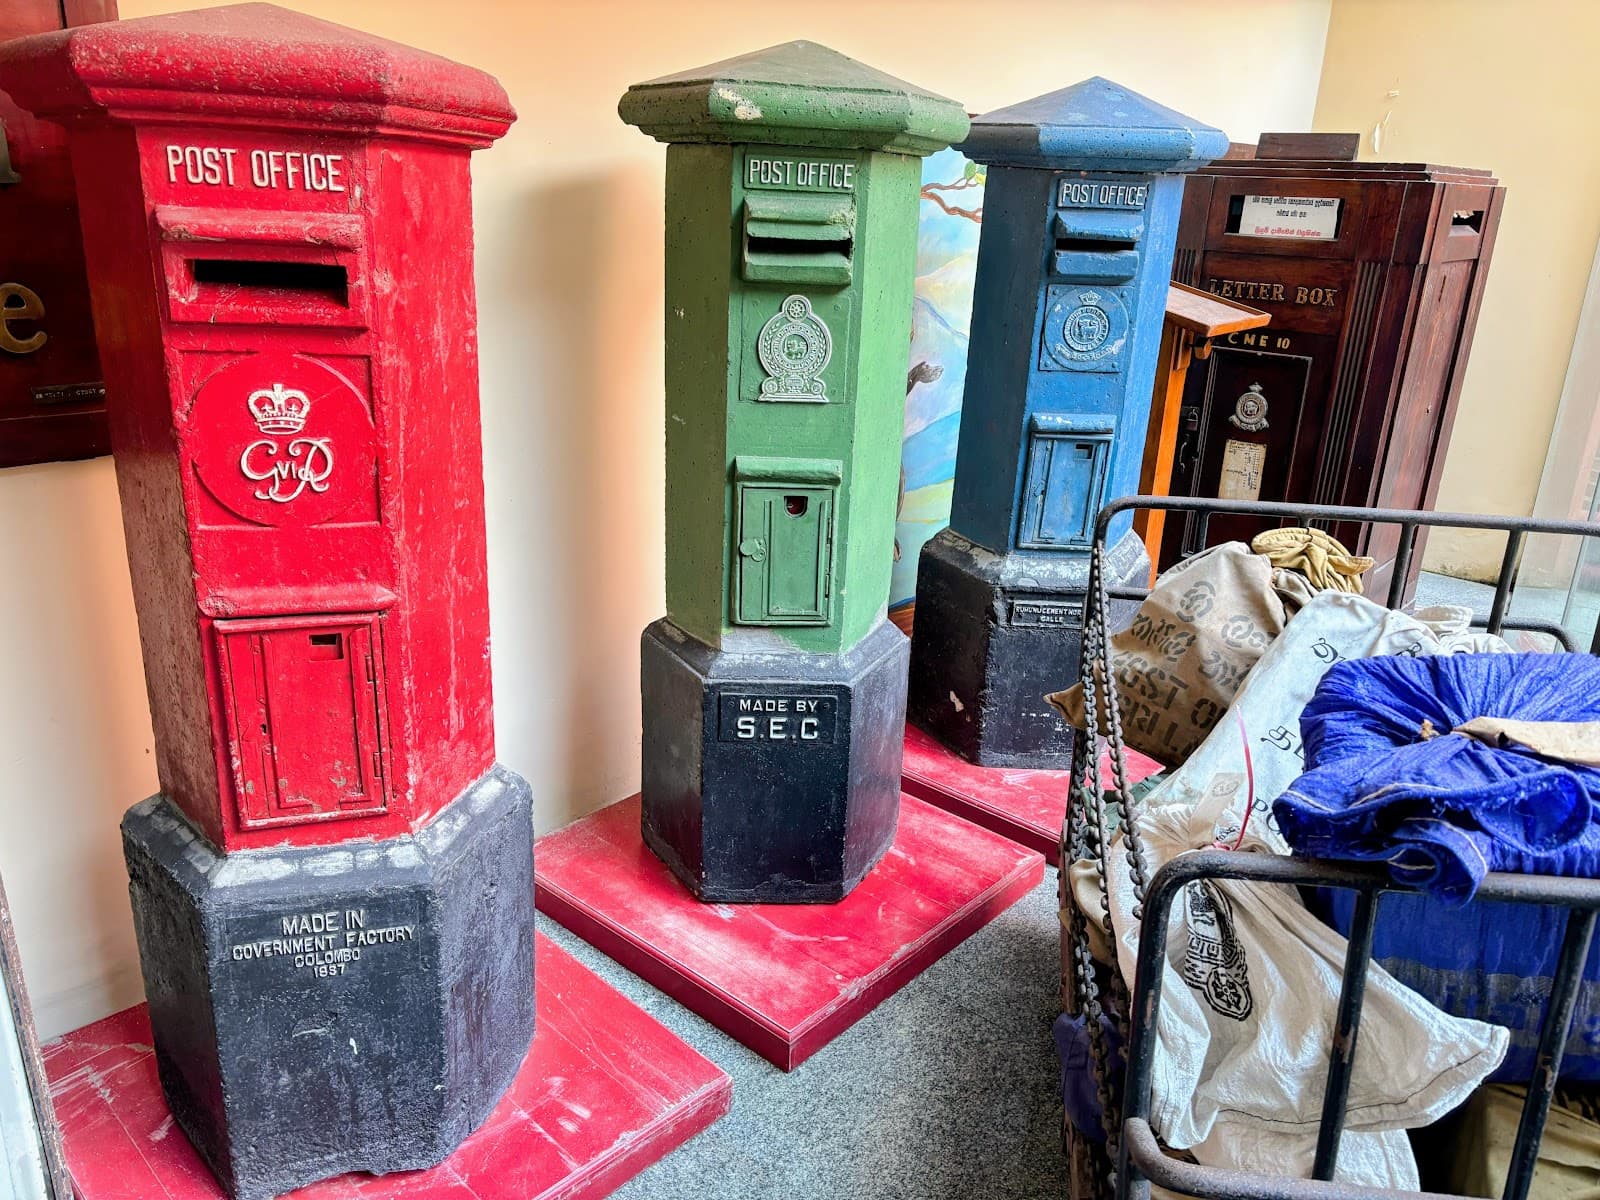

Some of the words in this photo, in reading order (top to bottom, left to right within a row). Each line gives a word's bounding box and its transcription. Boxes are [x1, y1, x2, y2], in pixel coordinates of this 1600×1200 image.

[166, 144, 237, 186] POST
[251, 149, 345, 193] OFFICE
[749, 159, 794, 185] POST
[797, 162, 855, 188] OFFICE
[1062, 182, 1098, 204] POST
[1099, 185, 1146, 206] OFFICE
[1209, 279, 1284, 301] LETTER
[1295, 286, 1338, 307] BOX
[1276, 337, 1291, 350] 10
[1040, 615, 1064, 623] GALLE
[740, 698, 789, 713] MADE
[796, 700, 818, 713] BY
[736, 716, 819, 741] S.E.C
[282, 912, 339, 936] MADE
[345, 909, 364, 930] IN
[232, 934, 337, 961] GOVERNMENT
[346, 924, 416, 948] FACTORY
[294, 947, 360, 968] COLOMBO
